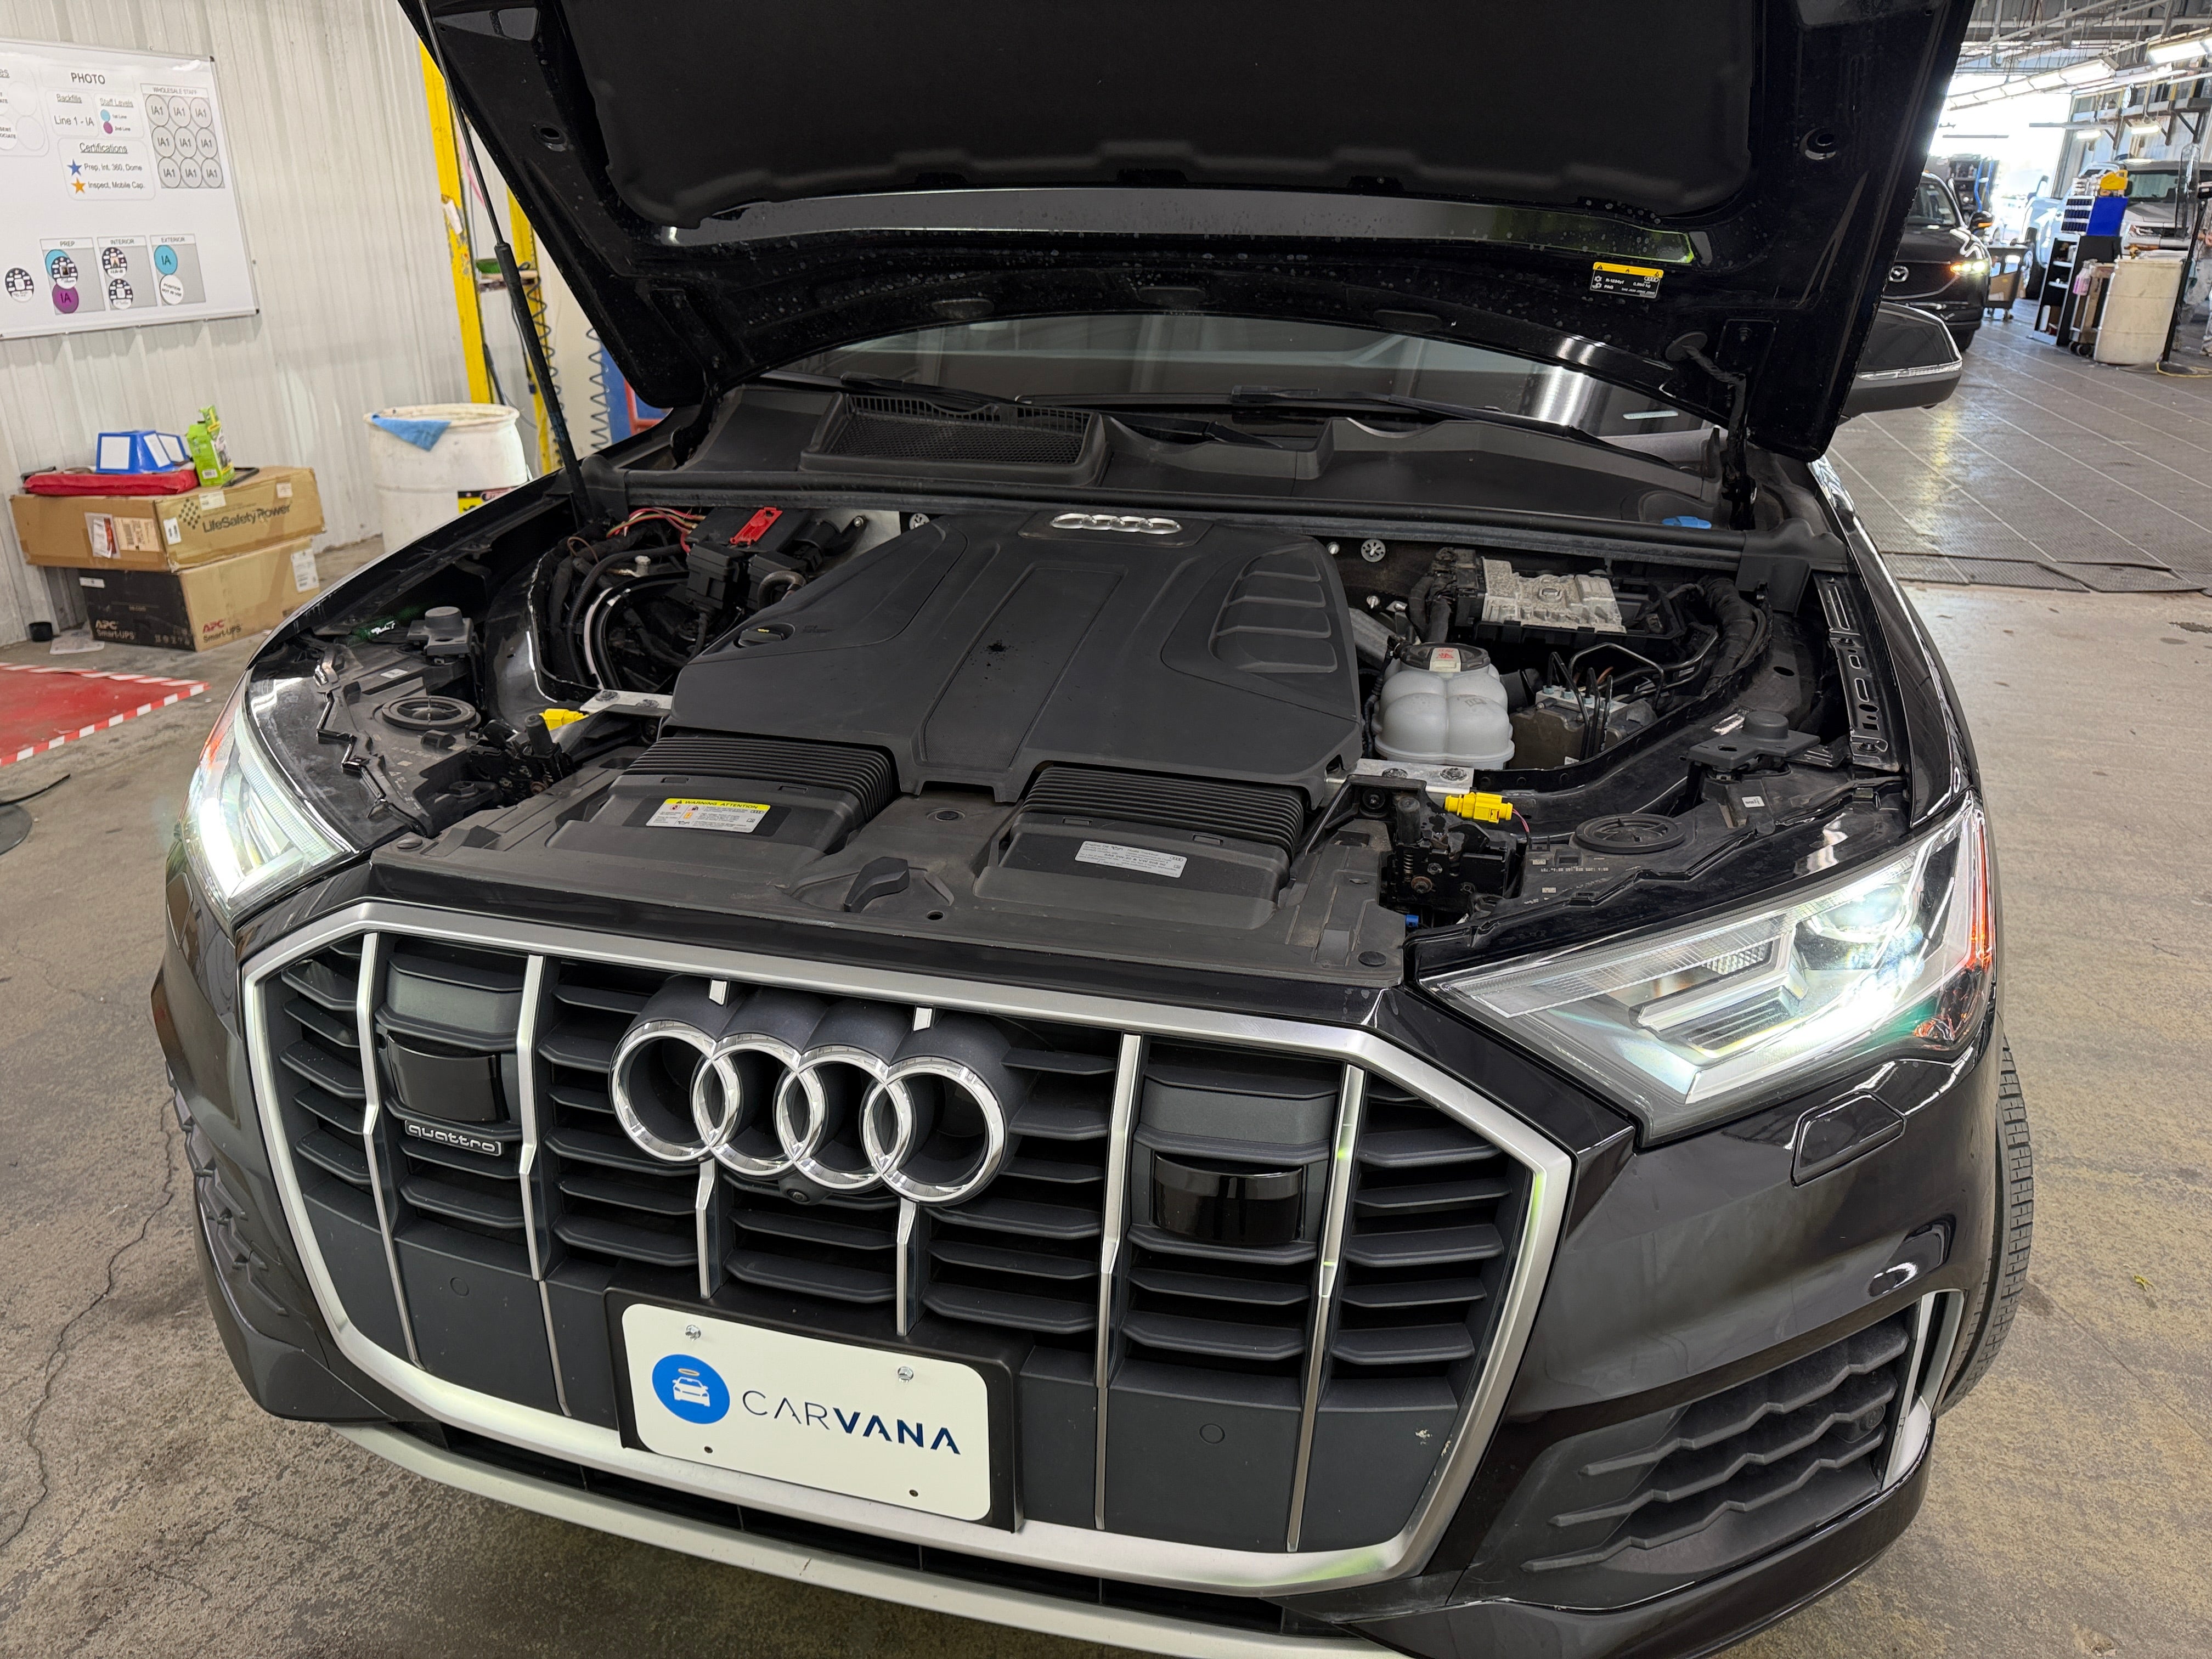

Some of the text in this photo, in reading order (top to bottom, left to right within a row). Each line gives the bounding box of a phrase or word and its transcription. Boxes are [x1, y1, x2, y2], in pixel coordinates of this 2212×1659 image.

[70, 72, 106, 84] PHOTO
[54, 115, 71, 125] Line
[80, 142, 128, 154] Certifications
[161, 255, 171, 266] IA
[60, 292, 72, 303] IA
[95, 619, 119, 630] APC
[202, 619, 226, 633] APC
[96, 629, 137, 640] Smart-UPS
[203, 623, 242, 643] Smart-UPS
[408, 1124, 496, 1152] quattro
[742, 1390, 961, 1455] CARVANA
